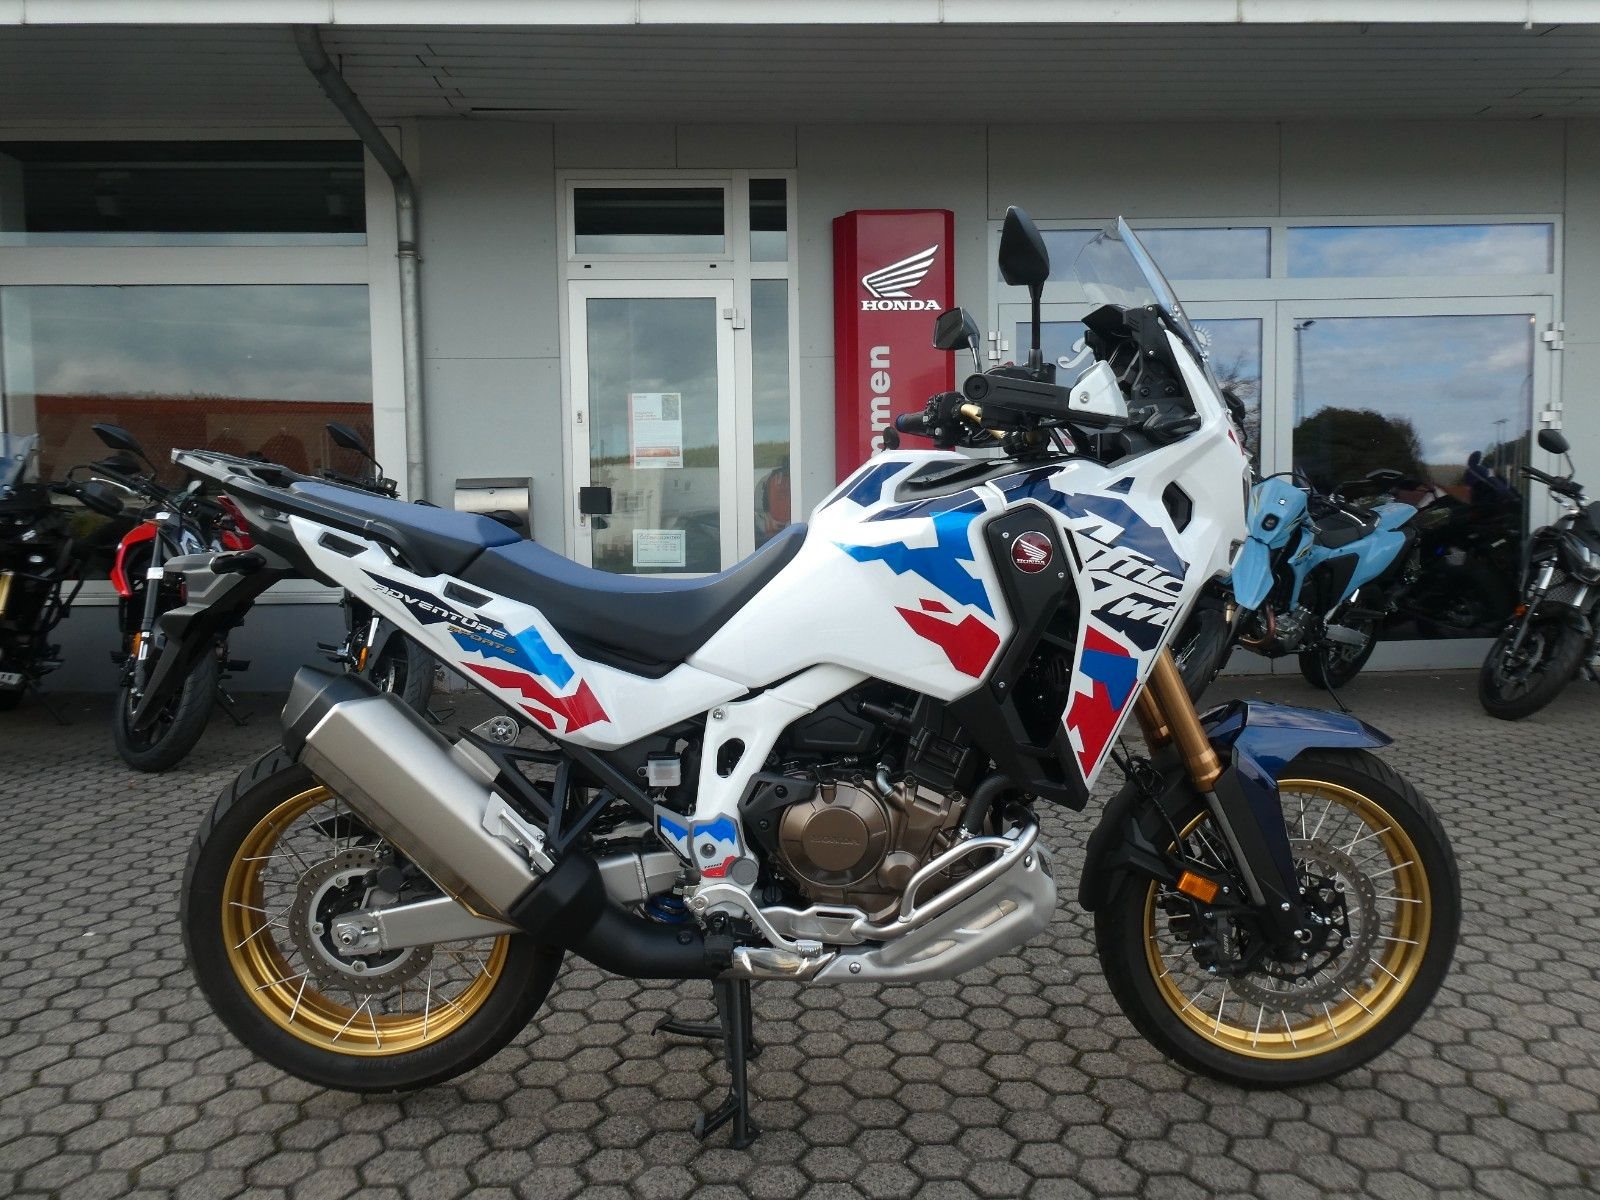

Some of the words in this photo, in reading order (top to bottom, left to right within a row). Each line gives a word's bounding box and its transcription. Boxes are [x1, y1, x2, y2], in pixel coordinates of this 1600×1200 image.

[860, 299, 942, 311] HONDA
[371, 583, 509, 641] ADVENTURE
[446, 623, 518, 656] SPORTS
